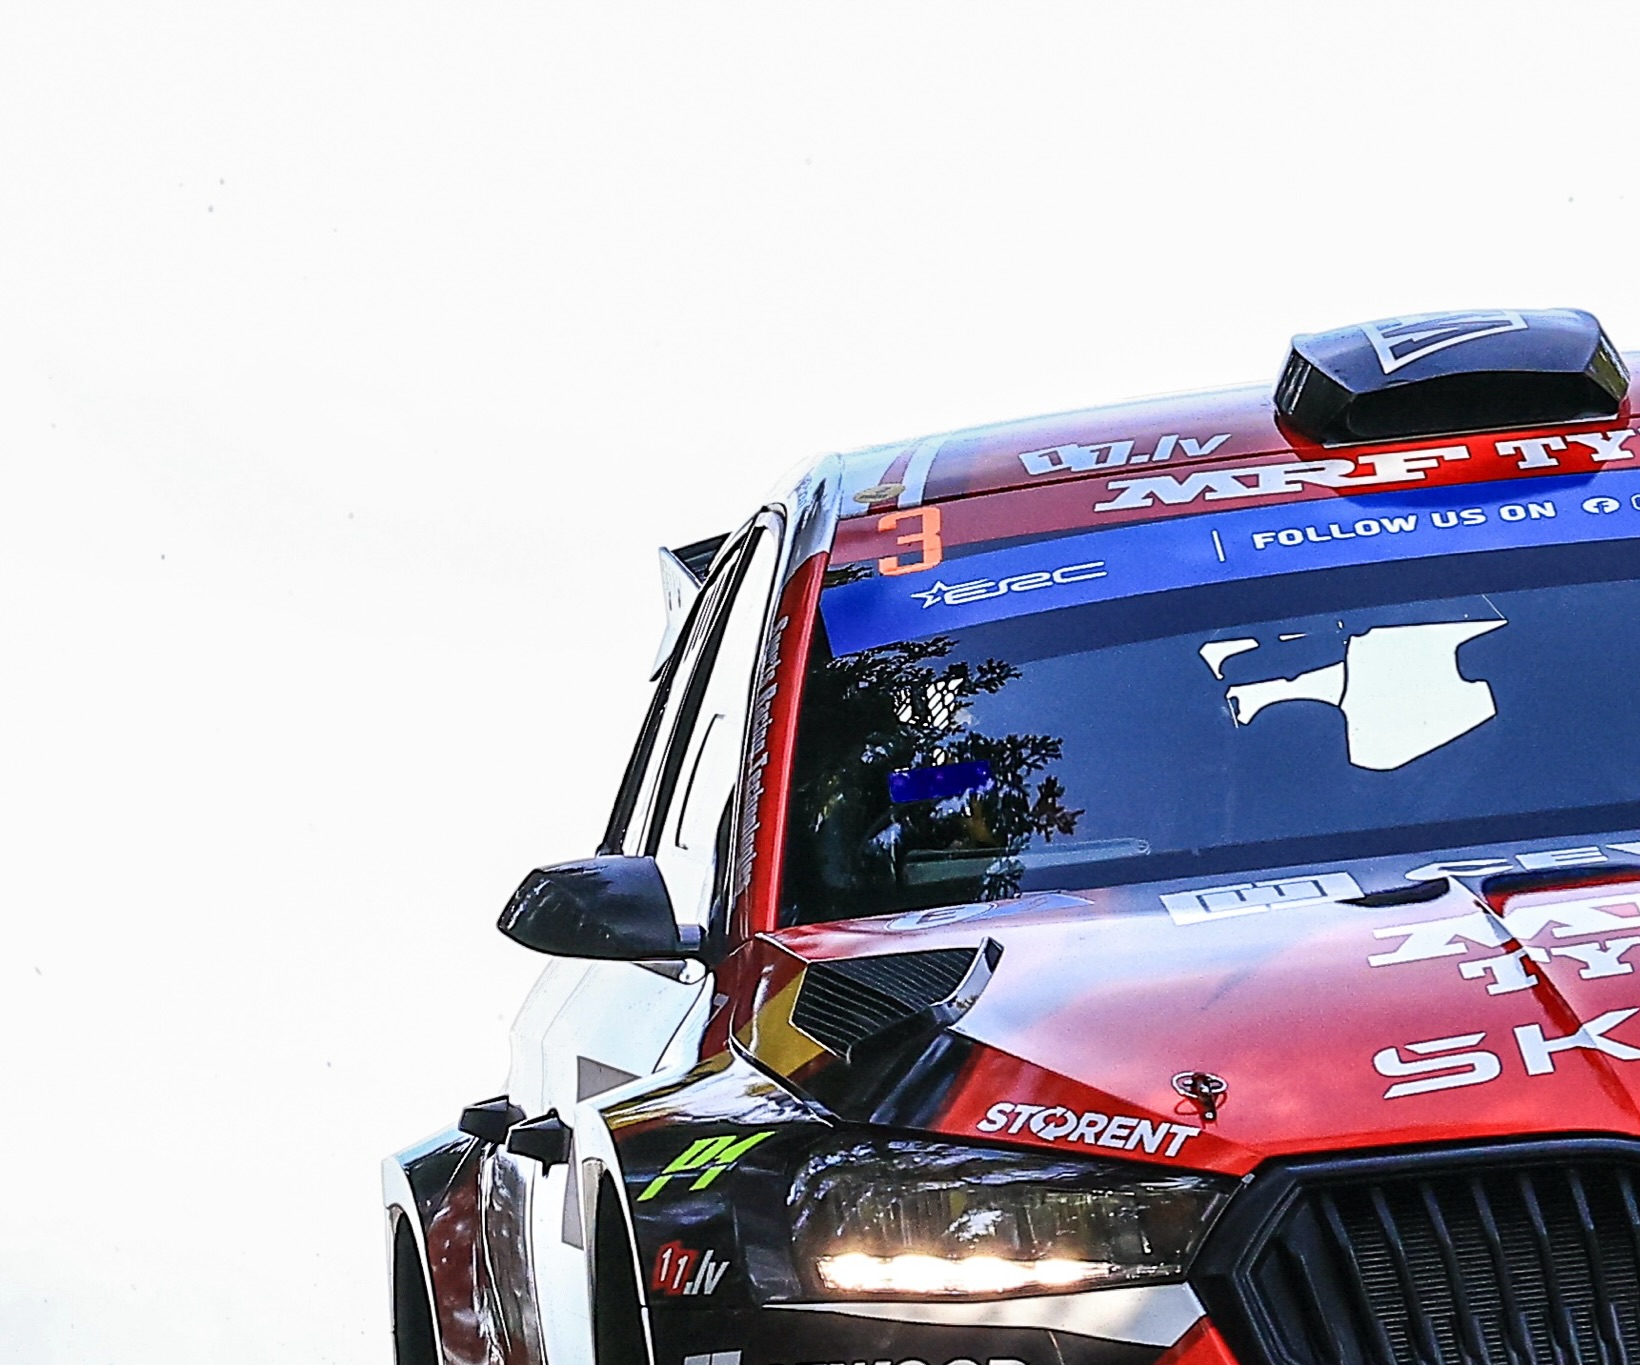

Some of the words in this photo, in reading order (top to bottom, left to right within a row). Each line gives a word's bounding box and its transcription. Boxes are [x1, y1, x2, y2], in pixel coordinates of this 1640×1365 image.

[1094, 445, 1470, 511] MRF
[877, 505, 943, 576] 3
[1252, 514, 1418, 550] FOLLOW
[1431, 508, 1487, 529] US
[1500, 501, 1557, 522] ON
